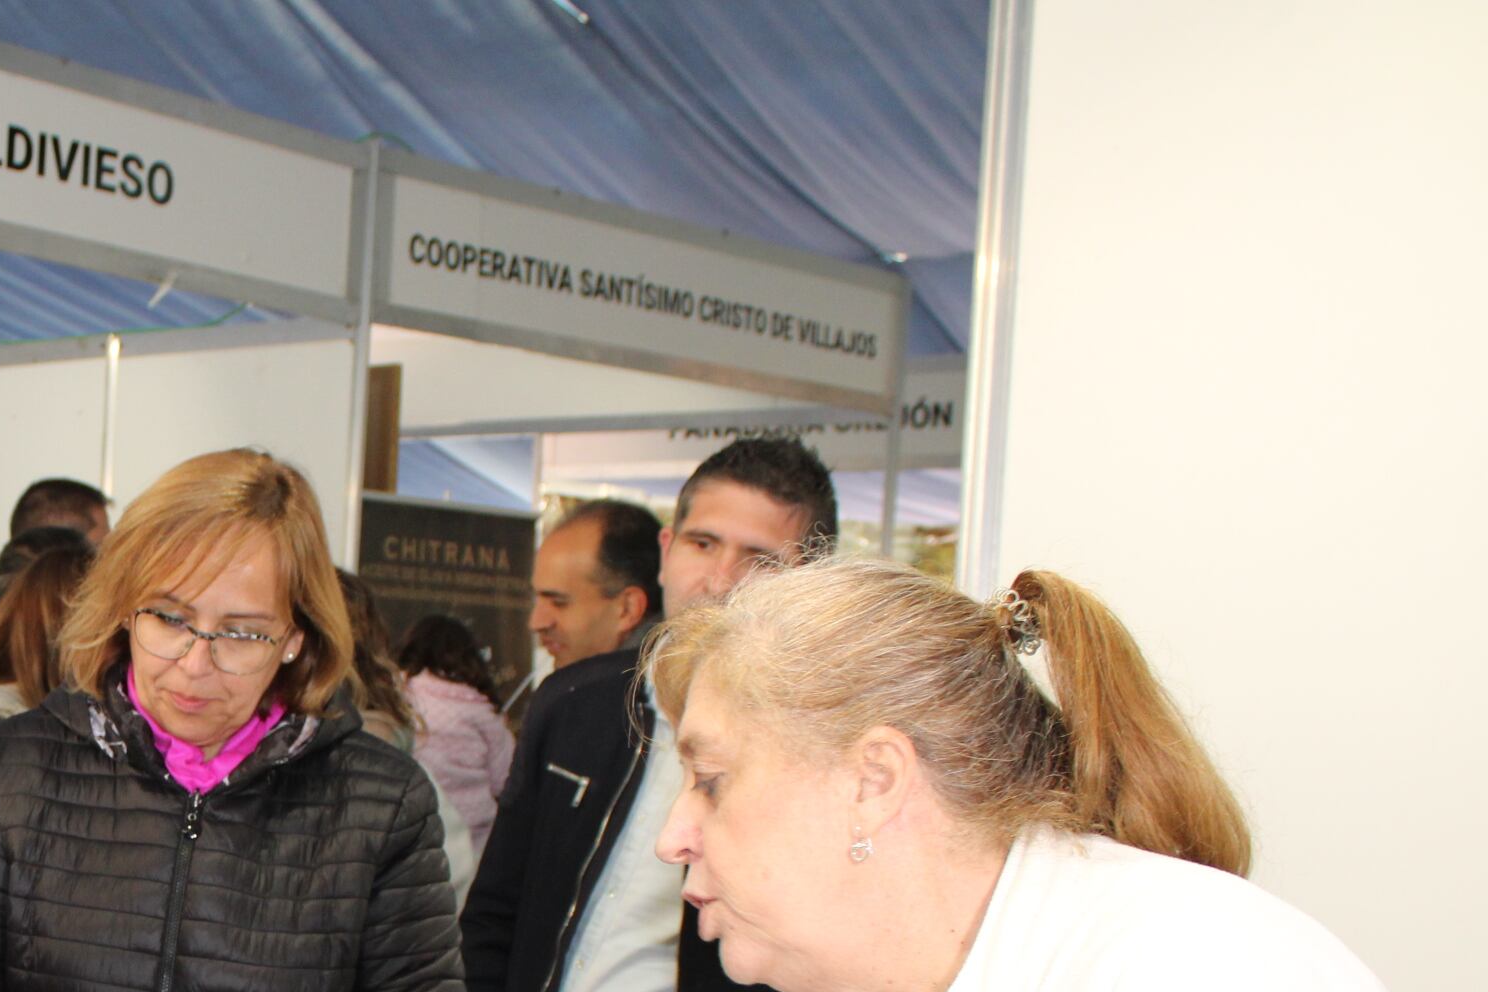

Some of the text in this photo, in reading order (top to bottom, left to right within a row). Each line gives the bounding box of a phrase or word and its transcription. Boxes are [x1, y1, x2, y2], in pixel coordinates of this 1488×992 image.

[409, 233, 877, 359] COOPERATIVA SANTÍSIMO CRISTO DE VILLAJOS
[383, 534, 511, 571] CHITRANA
